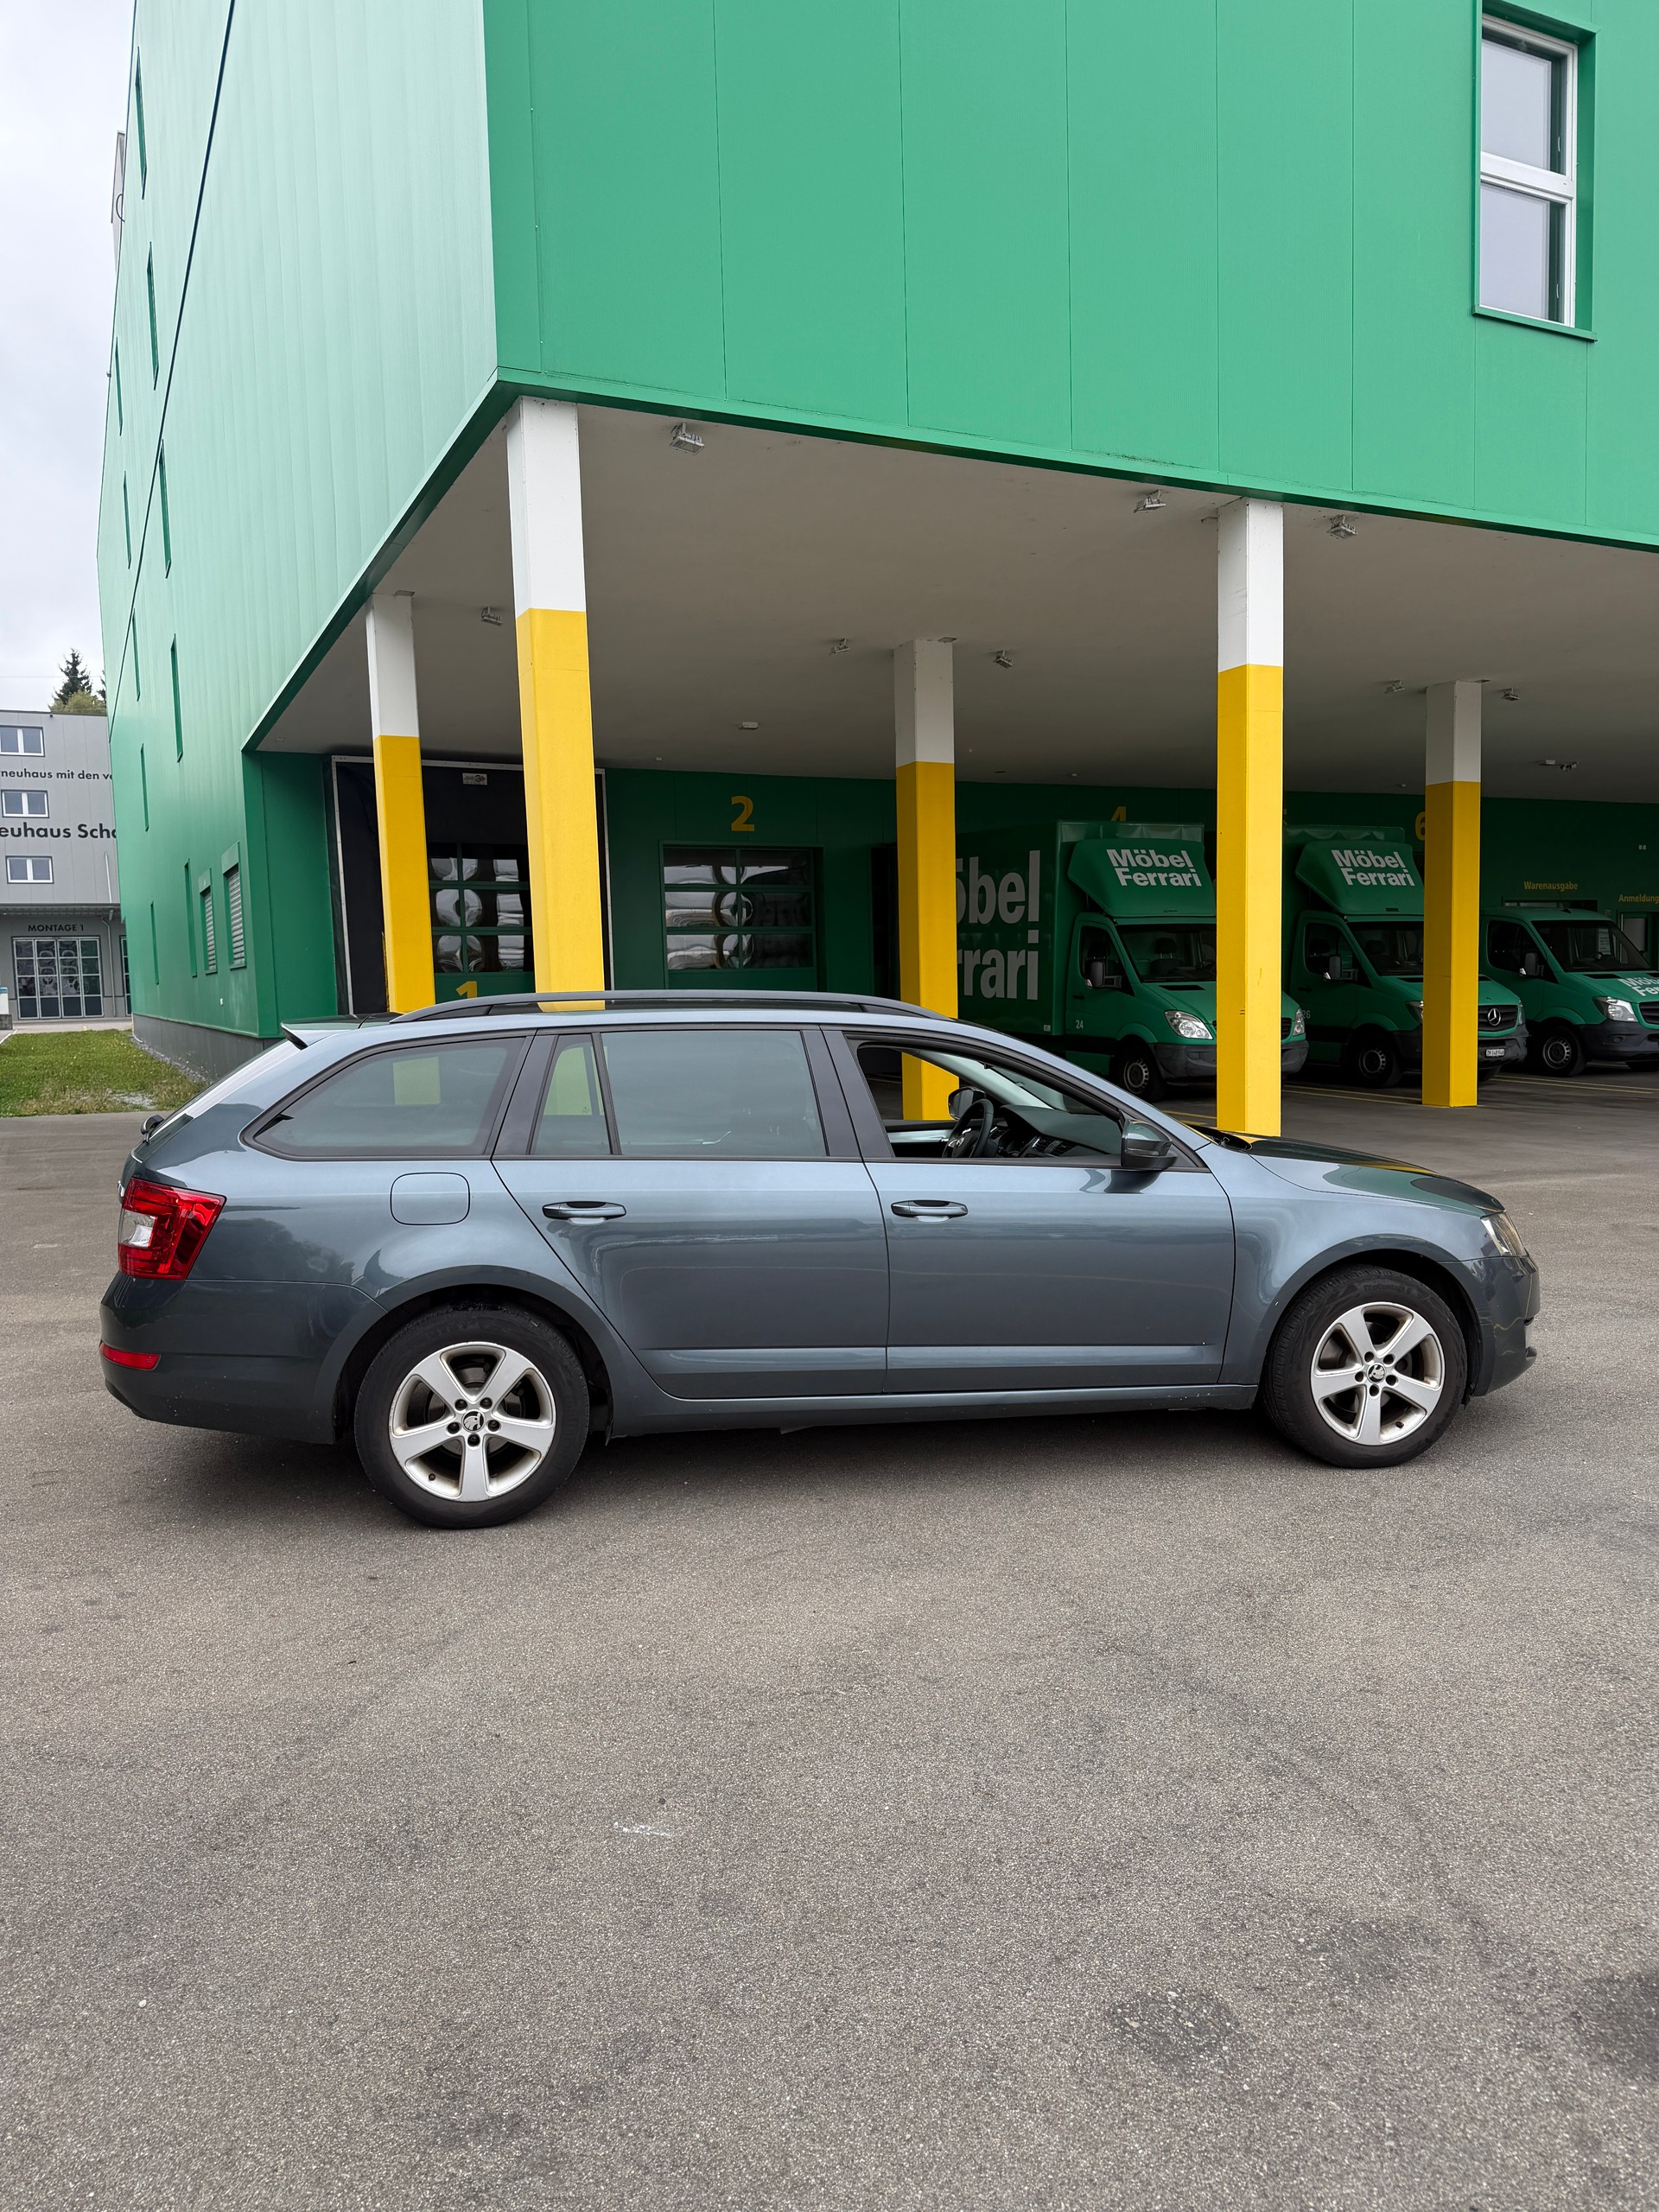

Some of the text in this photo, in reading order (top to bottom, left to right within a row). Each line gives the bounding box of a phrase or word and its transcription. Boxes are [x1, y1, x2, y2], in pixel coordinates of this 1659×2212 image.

[2, 768, 53, 778] neuhaus
[56, 770, 74, 779] mit
[78, 770, 99, 779] den
[731, 796, 755, 831] 2
[1106, 849, 1194, 868] Möbel
[1332, 850, 1406, 868] Möbel
[1115, 868, 1202, 887] Ferrari
[1340, 868, 1415, 886] Ferrari
[1523, 880, 1579, 892] Warenausgabe
[1618, 893, 1659, 904] Anmeldung
[1076, 1020, 1084, 1029] 24
